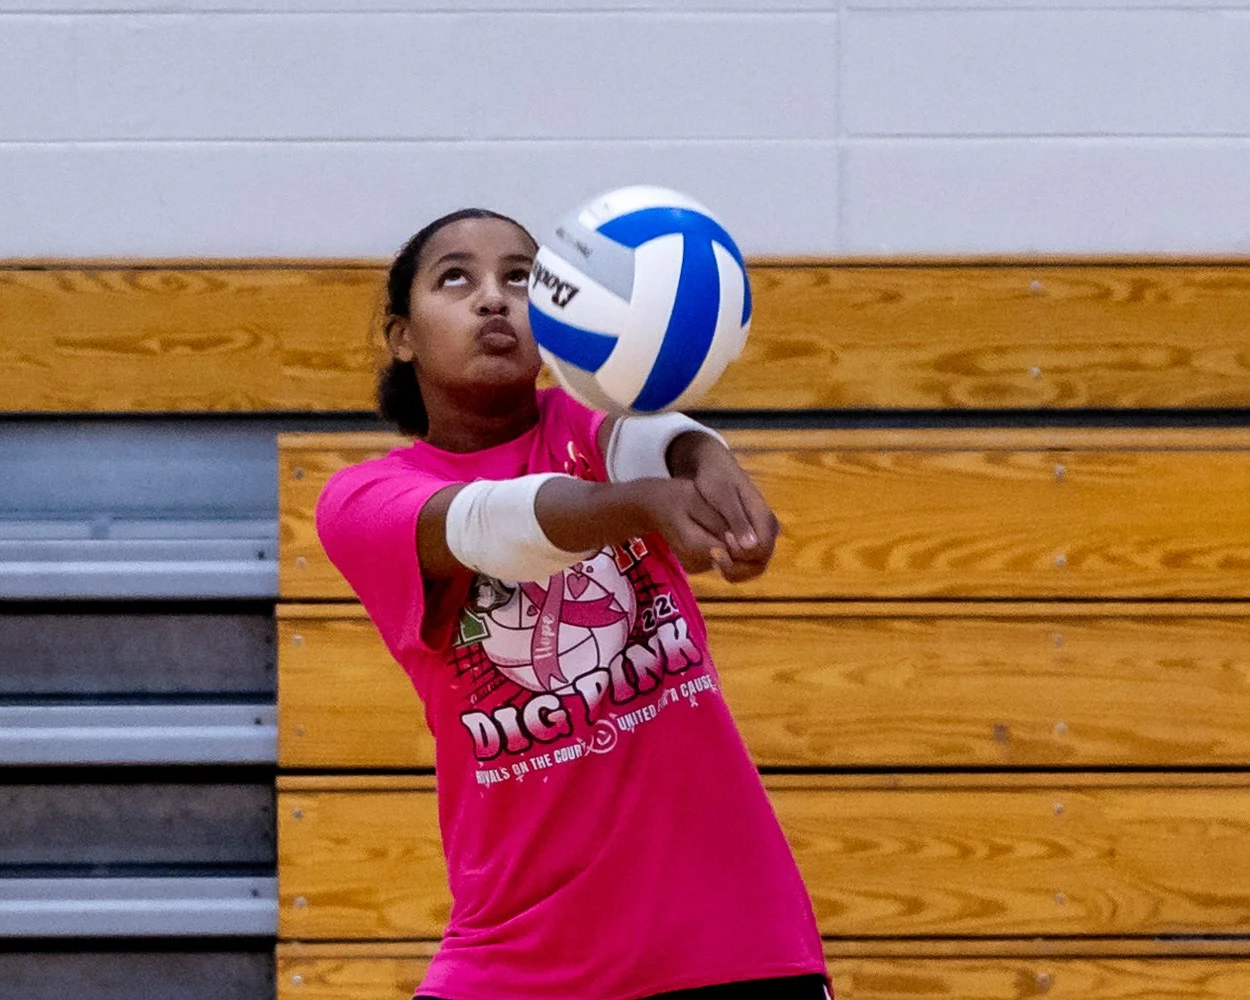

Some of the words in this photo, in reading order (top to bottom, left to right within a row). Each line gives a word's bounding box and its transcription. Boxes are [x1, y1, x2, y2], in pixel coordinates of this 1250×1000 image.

[460, 692, 574, 762] DIG
[573, 616, 704, 726] PINK
[616, 707, 658, 732] UNITED
[475, 766, 511, 787] RIVALS
[512, 762, 529, 778] ON
[530, 752, 553, 772] THE
